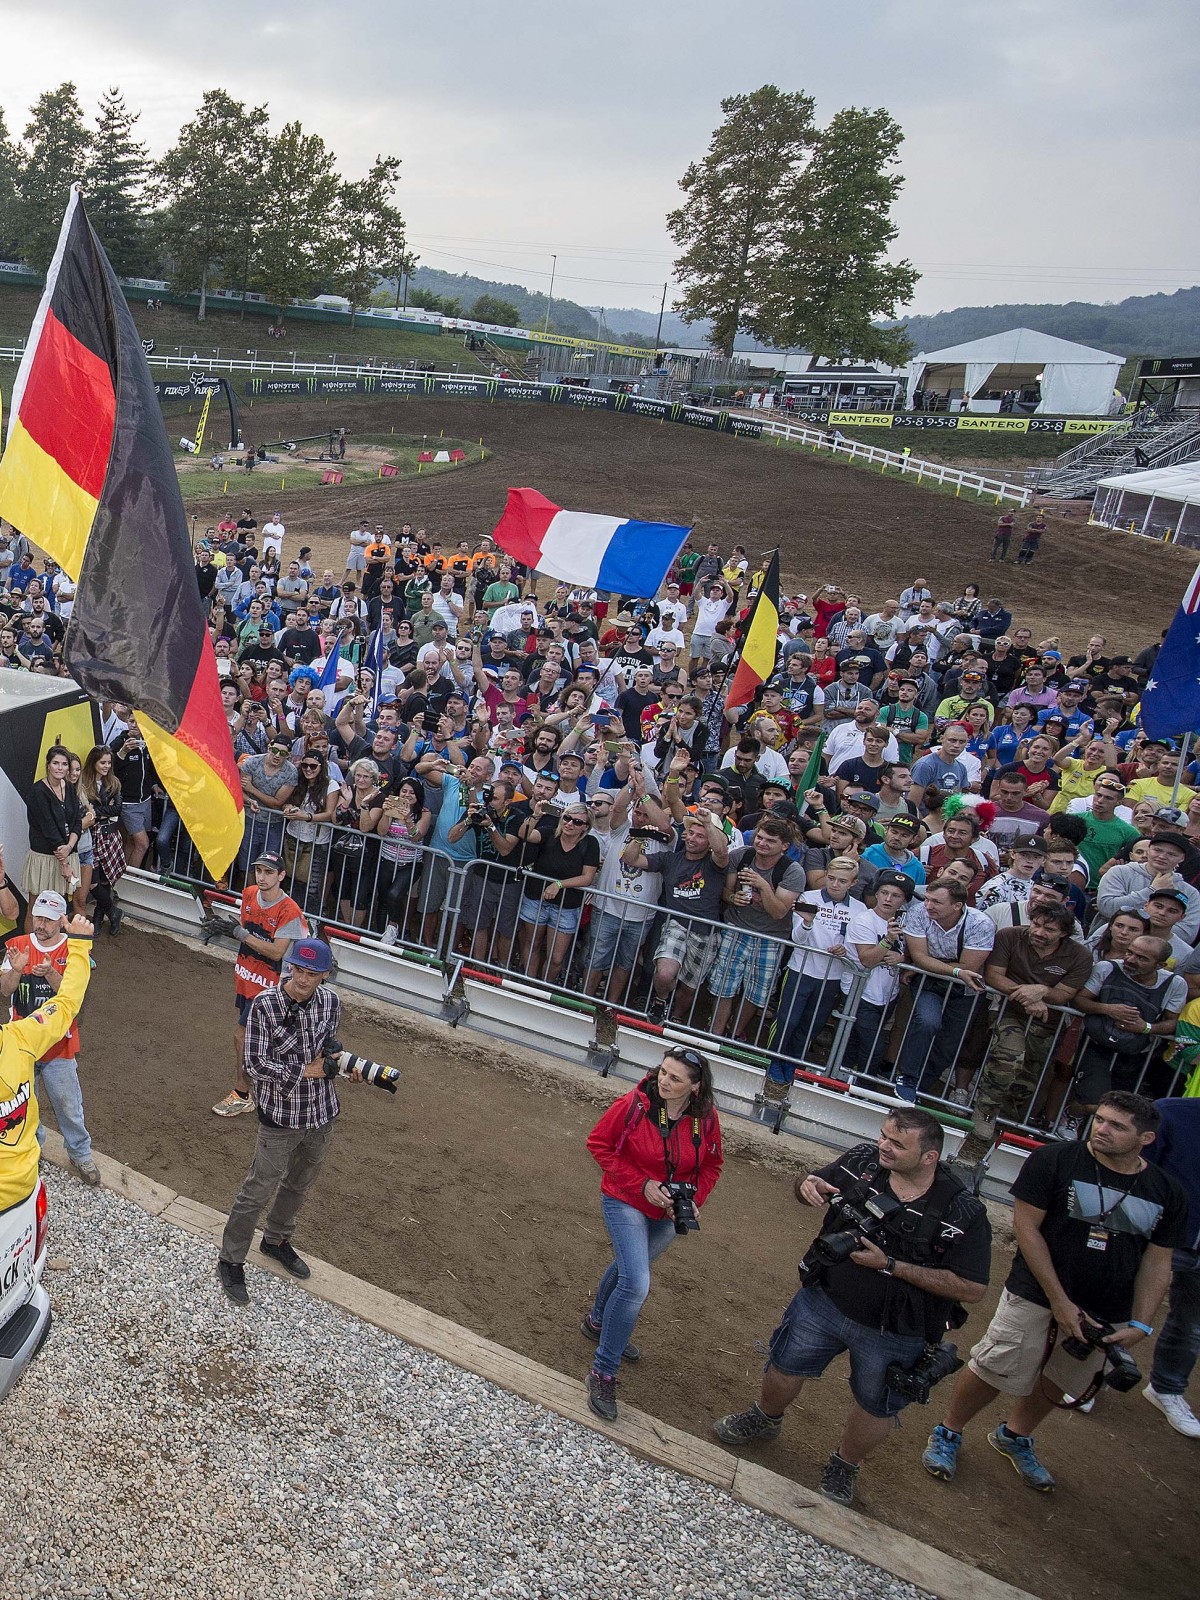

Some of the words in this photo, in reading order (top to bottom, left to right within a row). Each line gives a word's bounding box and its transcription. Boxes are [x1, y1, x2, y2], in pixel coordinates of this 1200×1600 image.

[541, 335, 575, 345] SAMMONTANA
[587, 342, 619, 352] SAMMONTANA
[441, 383, 478, 391] MONSTER
[503, 387, 542, 396] MONSTER
[568, 392, 608, 404] MONSTER
[632, 401, 666, 414] MONSTER
[684, 411, 713, 423] MONSTER
[832, 414, 890, 424] SANTERO
[731, 421, 762, 433] MONSTER
[961, 419, 1025, 429] SANTERO
[820, 913, 851, 922] OCEAN
[234, 963, 276, 989] ARSHALL
[660, 1107, 668, 1125] Nikon
[1067, 1186, 1077, 1211] PUKAS
